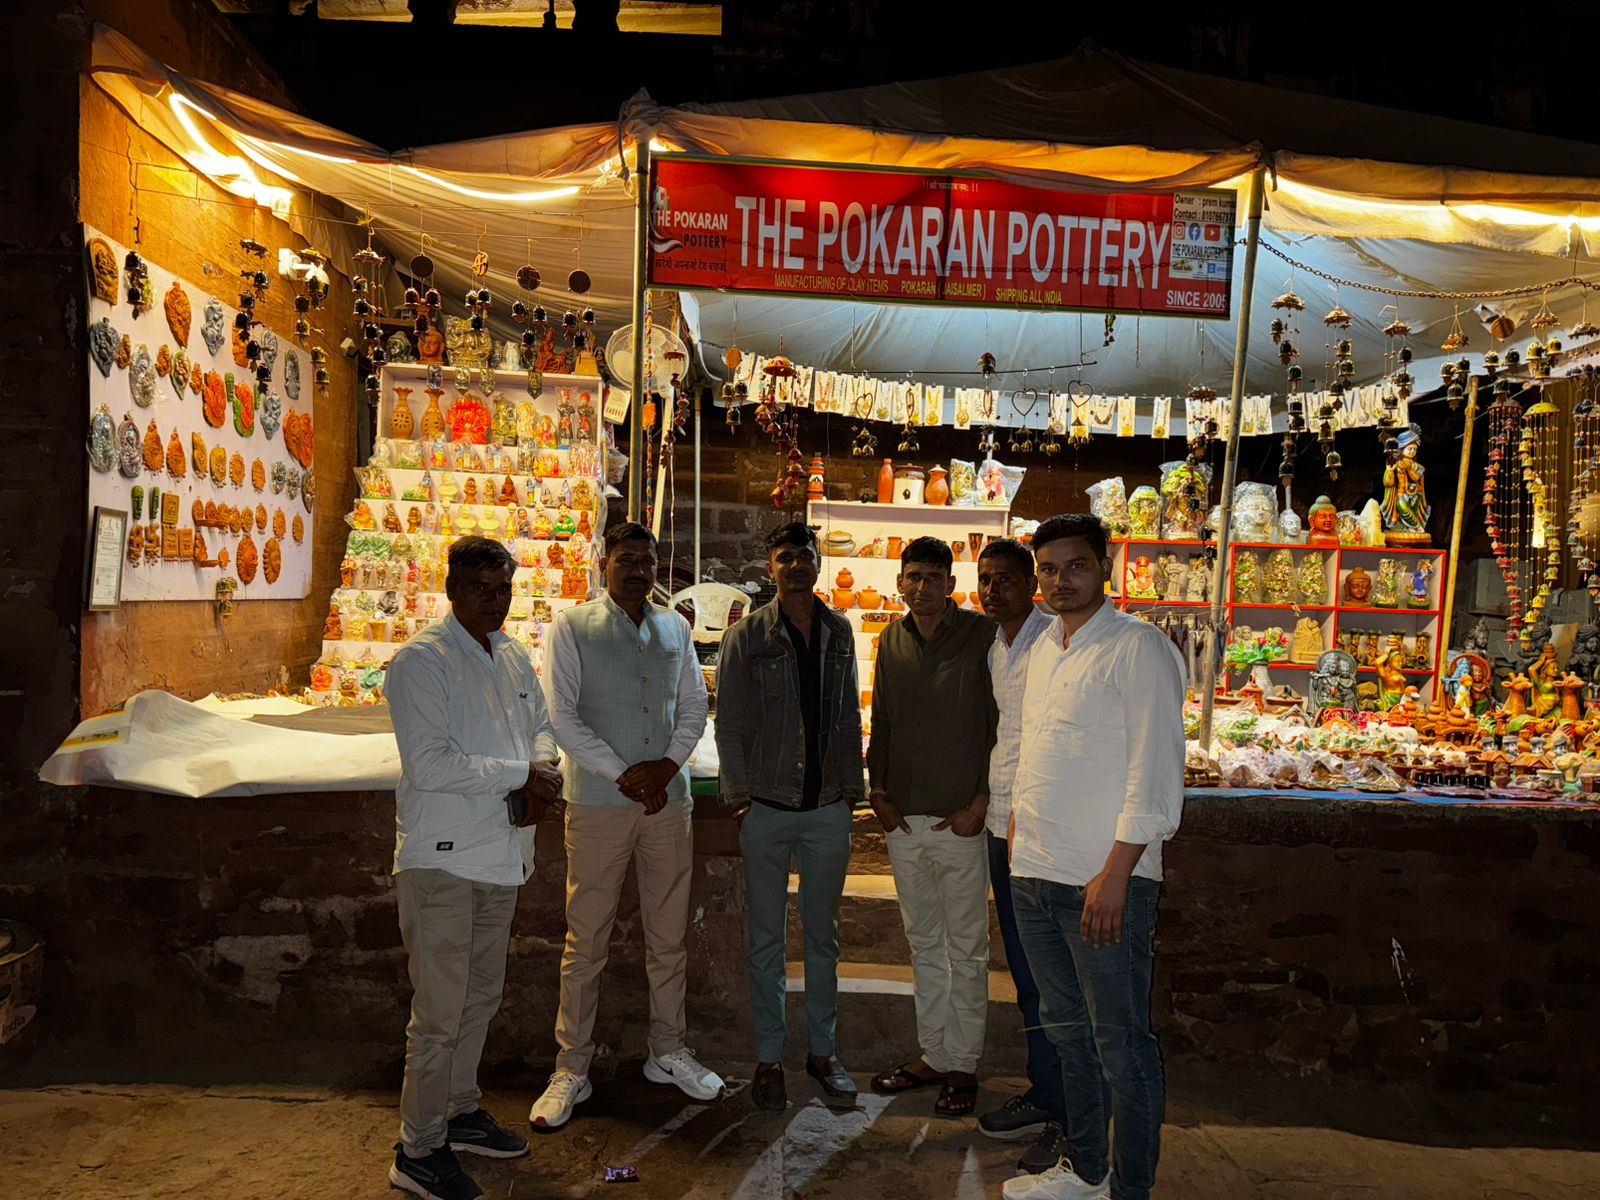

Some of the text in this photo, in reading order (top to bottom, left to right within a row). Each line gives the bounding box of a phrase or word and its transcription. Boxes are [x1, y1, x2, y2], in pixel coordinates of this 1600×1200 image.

[1175, 194, 1194, 205] Owner
[674, 211, 728, 231] POKARAN
[1174, 208, 1196, 219] Contact
[684, 234, 727, 248] POTTERY
[735, 196, 1170, 290] THE POKARAN POTTERY
[774, 273, 836, 290] MANUFACTURING
[836, 276, 847, 290] OF
[848, 277, 865, 291] CLAY
[901, 280, 936, 295] POKARAN
[996, 288, 1028, 302] SHIPPING
[1029, 289, 1043, 303] ALL
[1167, 290, 1227, 309] SINCE 2005
